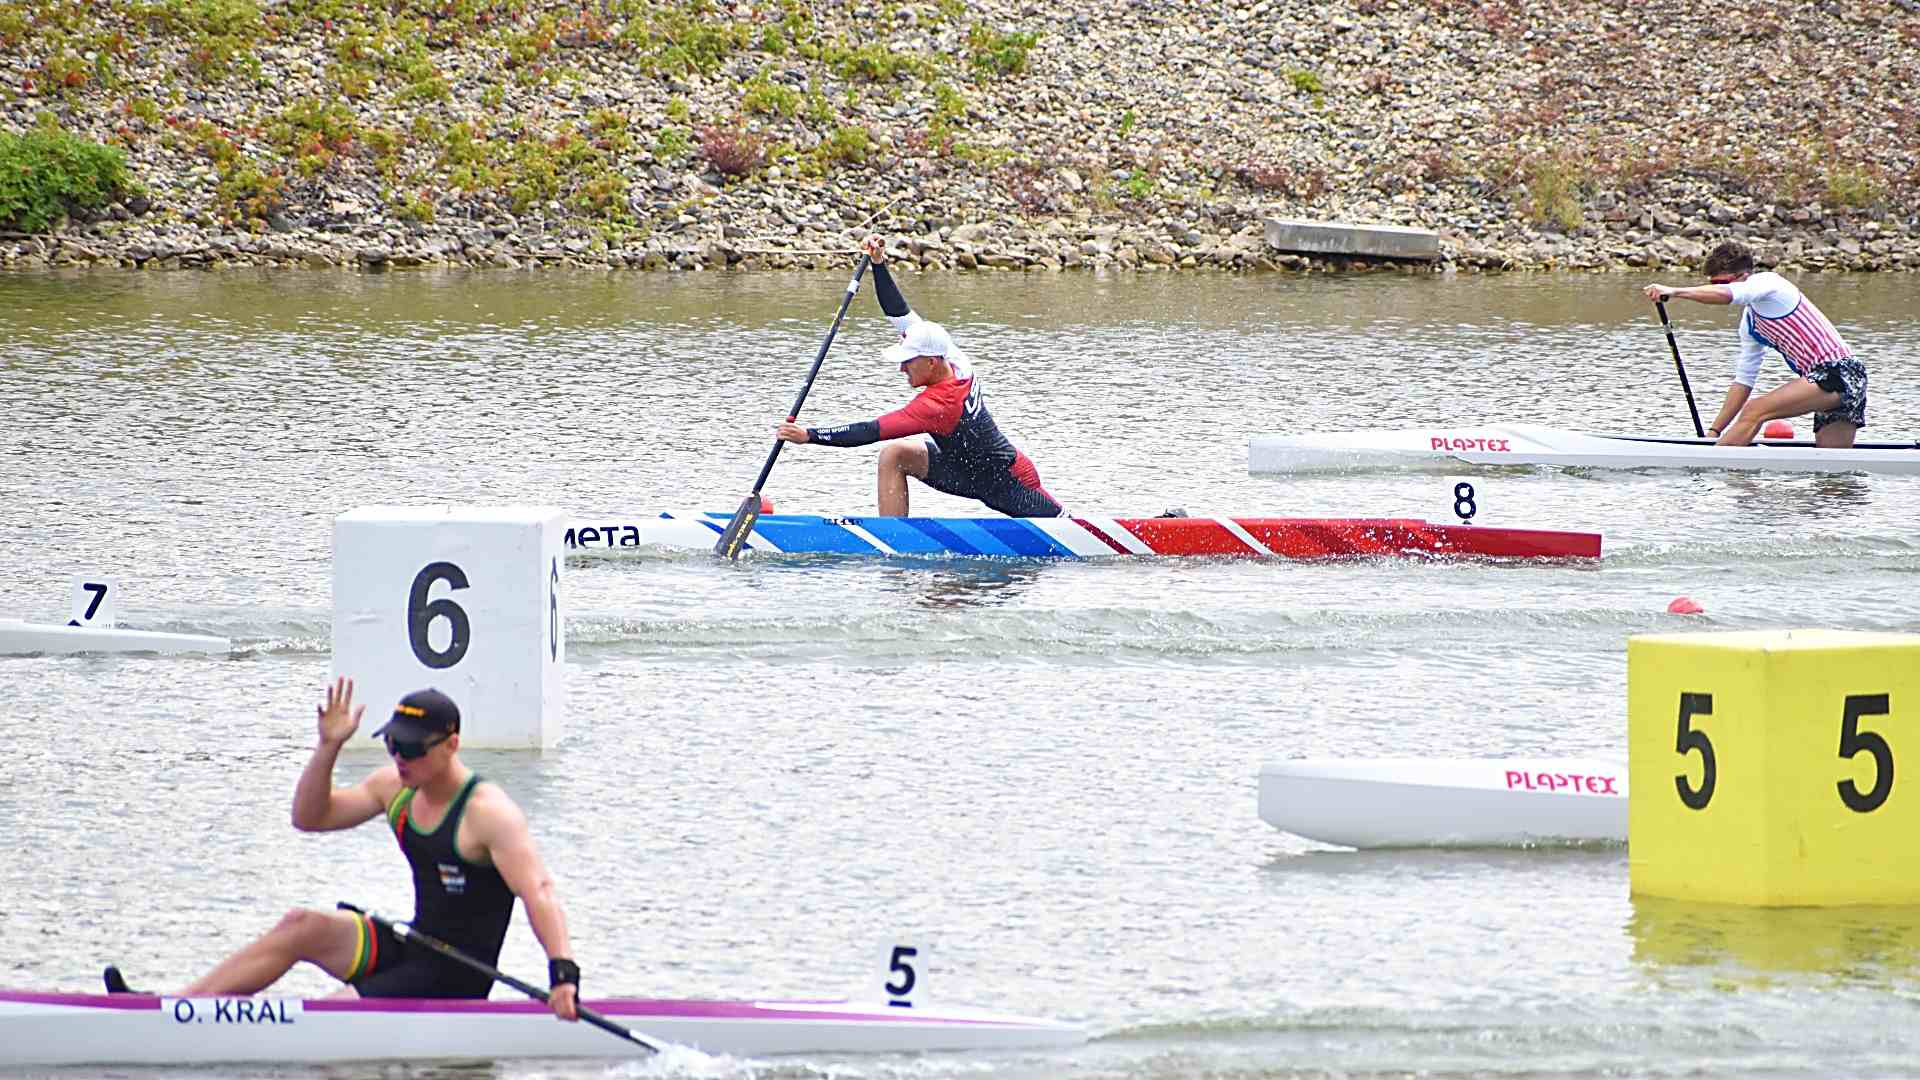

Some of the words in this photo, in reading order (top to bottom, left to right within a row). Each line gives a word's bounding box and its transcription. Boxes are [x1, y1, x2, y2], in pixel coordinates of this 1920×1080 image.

[1453, 482, 1477, 519] 8
[83, 582, 108, 621] 7
[407, 561, 471, 669] 6
[1675, 692, 1717, 810] 5
[1836, 692, 1895, 813] 5
[885, 945, 918, 996] 5
[174, 998, 202, 1024] O.
[215, 998, 295, 1024] KRAL
